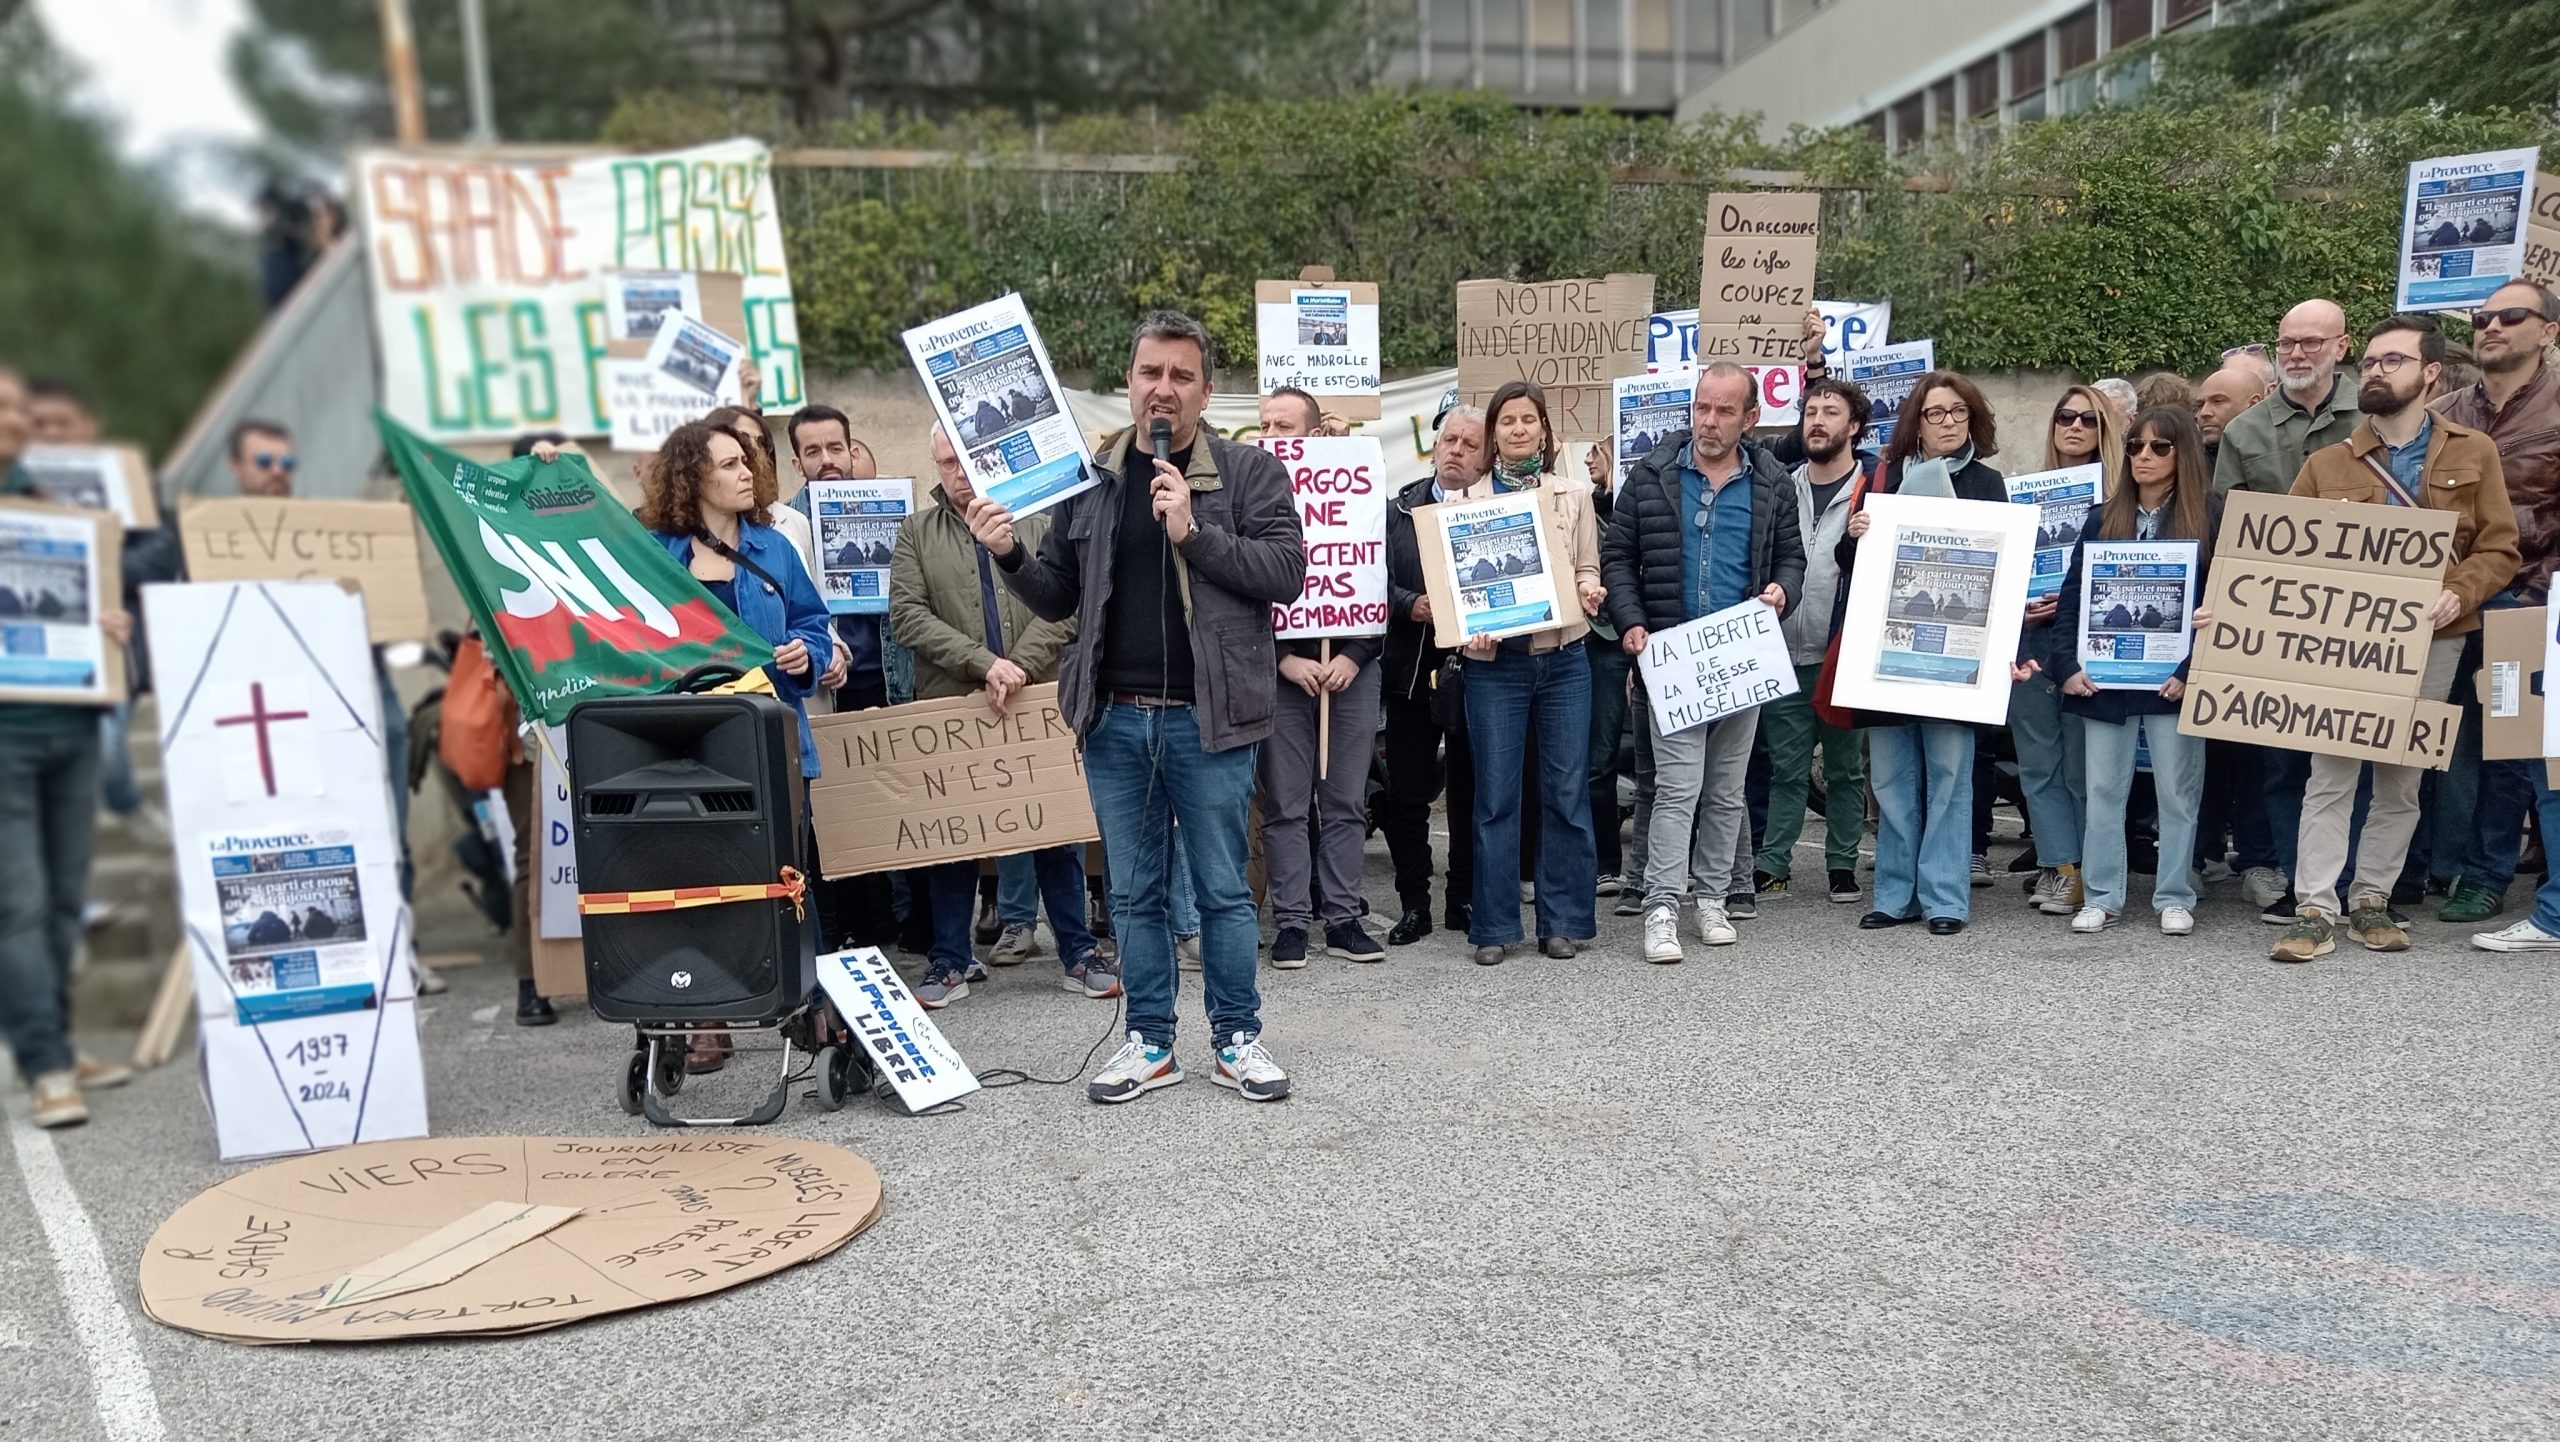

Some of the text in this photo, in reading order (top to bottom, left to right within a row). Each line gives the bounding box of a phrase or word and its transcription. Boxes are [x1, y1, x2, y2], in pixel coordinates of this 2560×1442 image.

[2431, 162, 2496, 178] Provence.
[2450, 198, 2475, 210] parti
[2476, 198, 2487, 206] et
[2450, 207, 2493, 218] toujours
[1721, 204, 1752, 233] On
[1721, 246, 1790, 275] les infos
[1496, 281, 1608, 317] NOTRE
[1721, 284, 1804, 306] COUPEZ
[1738, 314, 1762, 330] pas
[1708, 328, 1808, 361] LES TÊTES
[411, 301, 560, 431] LES
[1266, 354, 1369, 367] AVEC MADROLLE
[1517, 356, 1604, 386] VOTRE
[972, 366, 996, 386] parti
[996, 363, 1008, 375] et
[976, 373, 1018, 394] toujours
[1264, 377, 1279, 389] LA
[520, 482, 596, 511] Solidaires
[1304, 501, 1348, 527] NE
[1910, 531, 1972, 546] Provence.
[2237, 512, 2450, 568] NOS INFOS
[2103, 550, 2161, 561] Provence.
[478, 514, 681, 640] SNJ
[1304, 572, 1356, 600] PAS
[1926, 570, 1950, 580] parti
[1952, 572, 1962, 580] et
[1926, 579, 1966, 590] toujours
[2122, 583, 2145, 594] parti
[2146, 584, 2155, 592] et
[2122, 592, 2160, 603] toujours
[2228, 574, 2424, 634] C'EST PAS
[1651, 610, 1770, 668] LA LIBERTE
[2212, 621, 2265, 656] DU
[1696, 656, 1721, 674] DE
[1664, 658, 1760, 700] LA PRESSE
[1706, 682, 1732, 696] EST
[1668, 678, 1784, 730] MUSELIER
[843, 707, 1067, 768] INFORMER
[923, 754, 1036, 800] N'EST
[897, 802, 1043, 851] AMBIGU
[265, 879, 298, 897] parti
[302, 878, 314, 890] et
[839, 955, 868, 982] LA
[286, 1034, 350, 1066] 1997
[299, 1081, 351, 1104] 2024
[600, 1155, 665, 1166] EN
[541, 1169, 681, 1181] COLERE
[218, 1214, 291, 1279] SAADE
